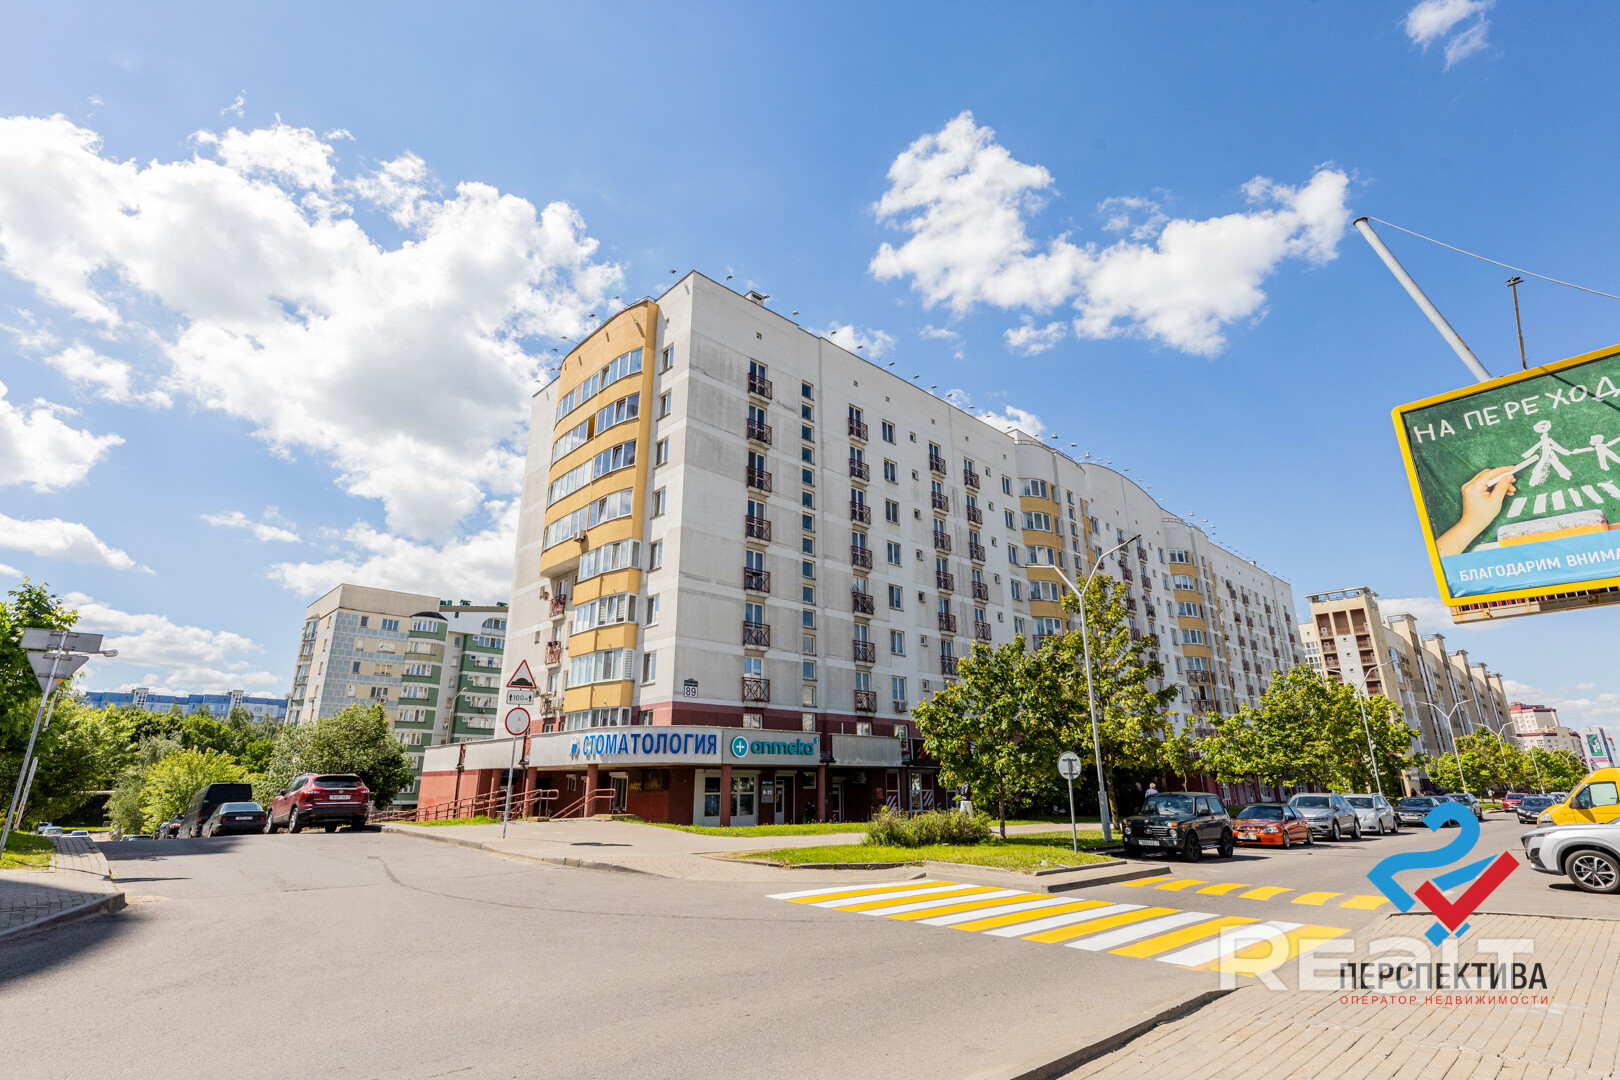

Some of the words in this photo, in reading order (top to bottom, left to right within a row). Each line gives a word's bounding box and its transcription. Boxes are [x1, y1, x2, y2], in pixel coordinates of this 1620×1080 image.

[1413, 419, 1456, 443] НА
[1459, 557, 1561, 581] БЛАГОДАРИМ
[686, 686, 697, 697] 89
[583, 733, 717, 755] СТОМАТОЛОГИЯ
